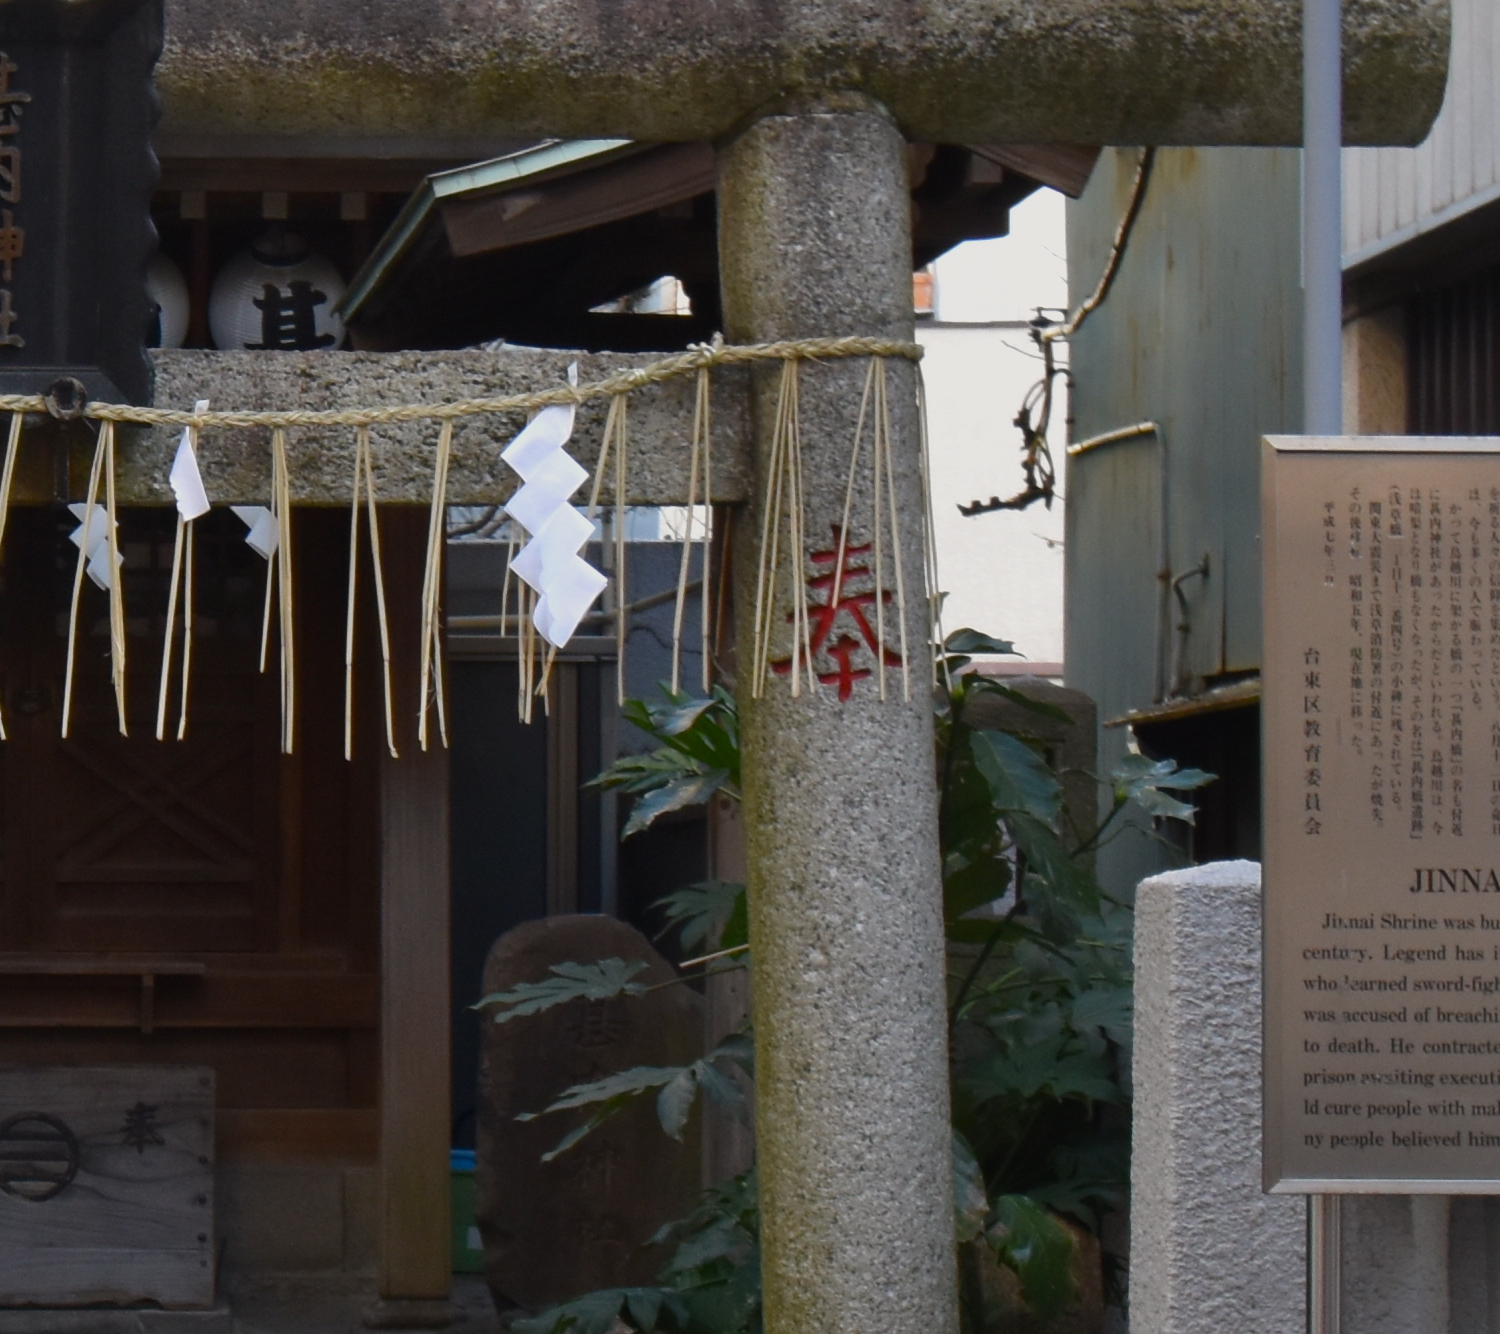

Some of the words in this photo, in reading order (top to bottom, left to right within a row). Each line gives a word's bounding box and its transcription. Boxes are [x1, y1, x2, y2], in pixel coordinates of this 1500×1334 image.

[770, 524, 910, 703] 奉
[1303, 647, 1323, 836] 台東区教育委員会
[1380, 913, 1438, 930] Shrine
[1443, 918, 1476, 930] was
[1302, 945, 1373, 963] centuy.
[1383, 944, 1447, 964] Legend
[1455, 944, 1484, 961] has
[1303, 975, 1339, 991] who
[1303, 1010, 1336, 1023] was
[1342, 1006, 1407, 1023] accused
[1414, 1007, 1431, 1023] of
[1304, 1039, 1320, 1053] to
[1328, 1037, 1380, 1054] death.
[1391, 1038, 1415, 1054] He
[1303, 1068, 1356, 1087] prison
[1304, 1099, 1319, 1115] ld
[1324, 1104, 1362, 1115] cure
[1367, 1099, 1421, 1119] people
[1428, 1100, 1465, 1116] with
[119, 1100, 166, 1155] 奉
[1304, 1134, 1323, 1149] ny
[1330, 1131, 1384, 1149] people
[1392, 1131, 1461, 1147] believed
